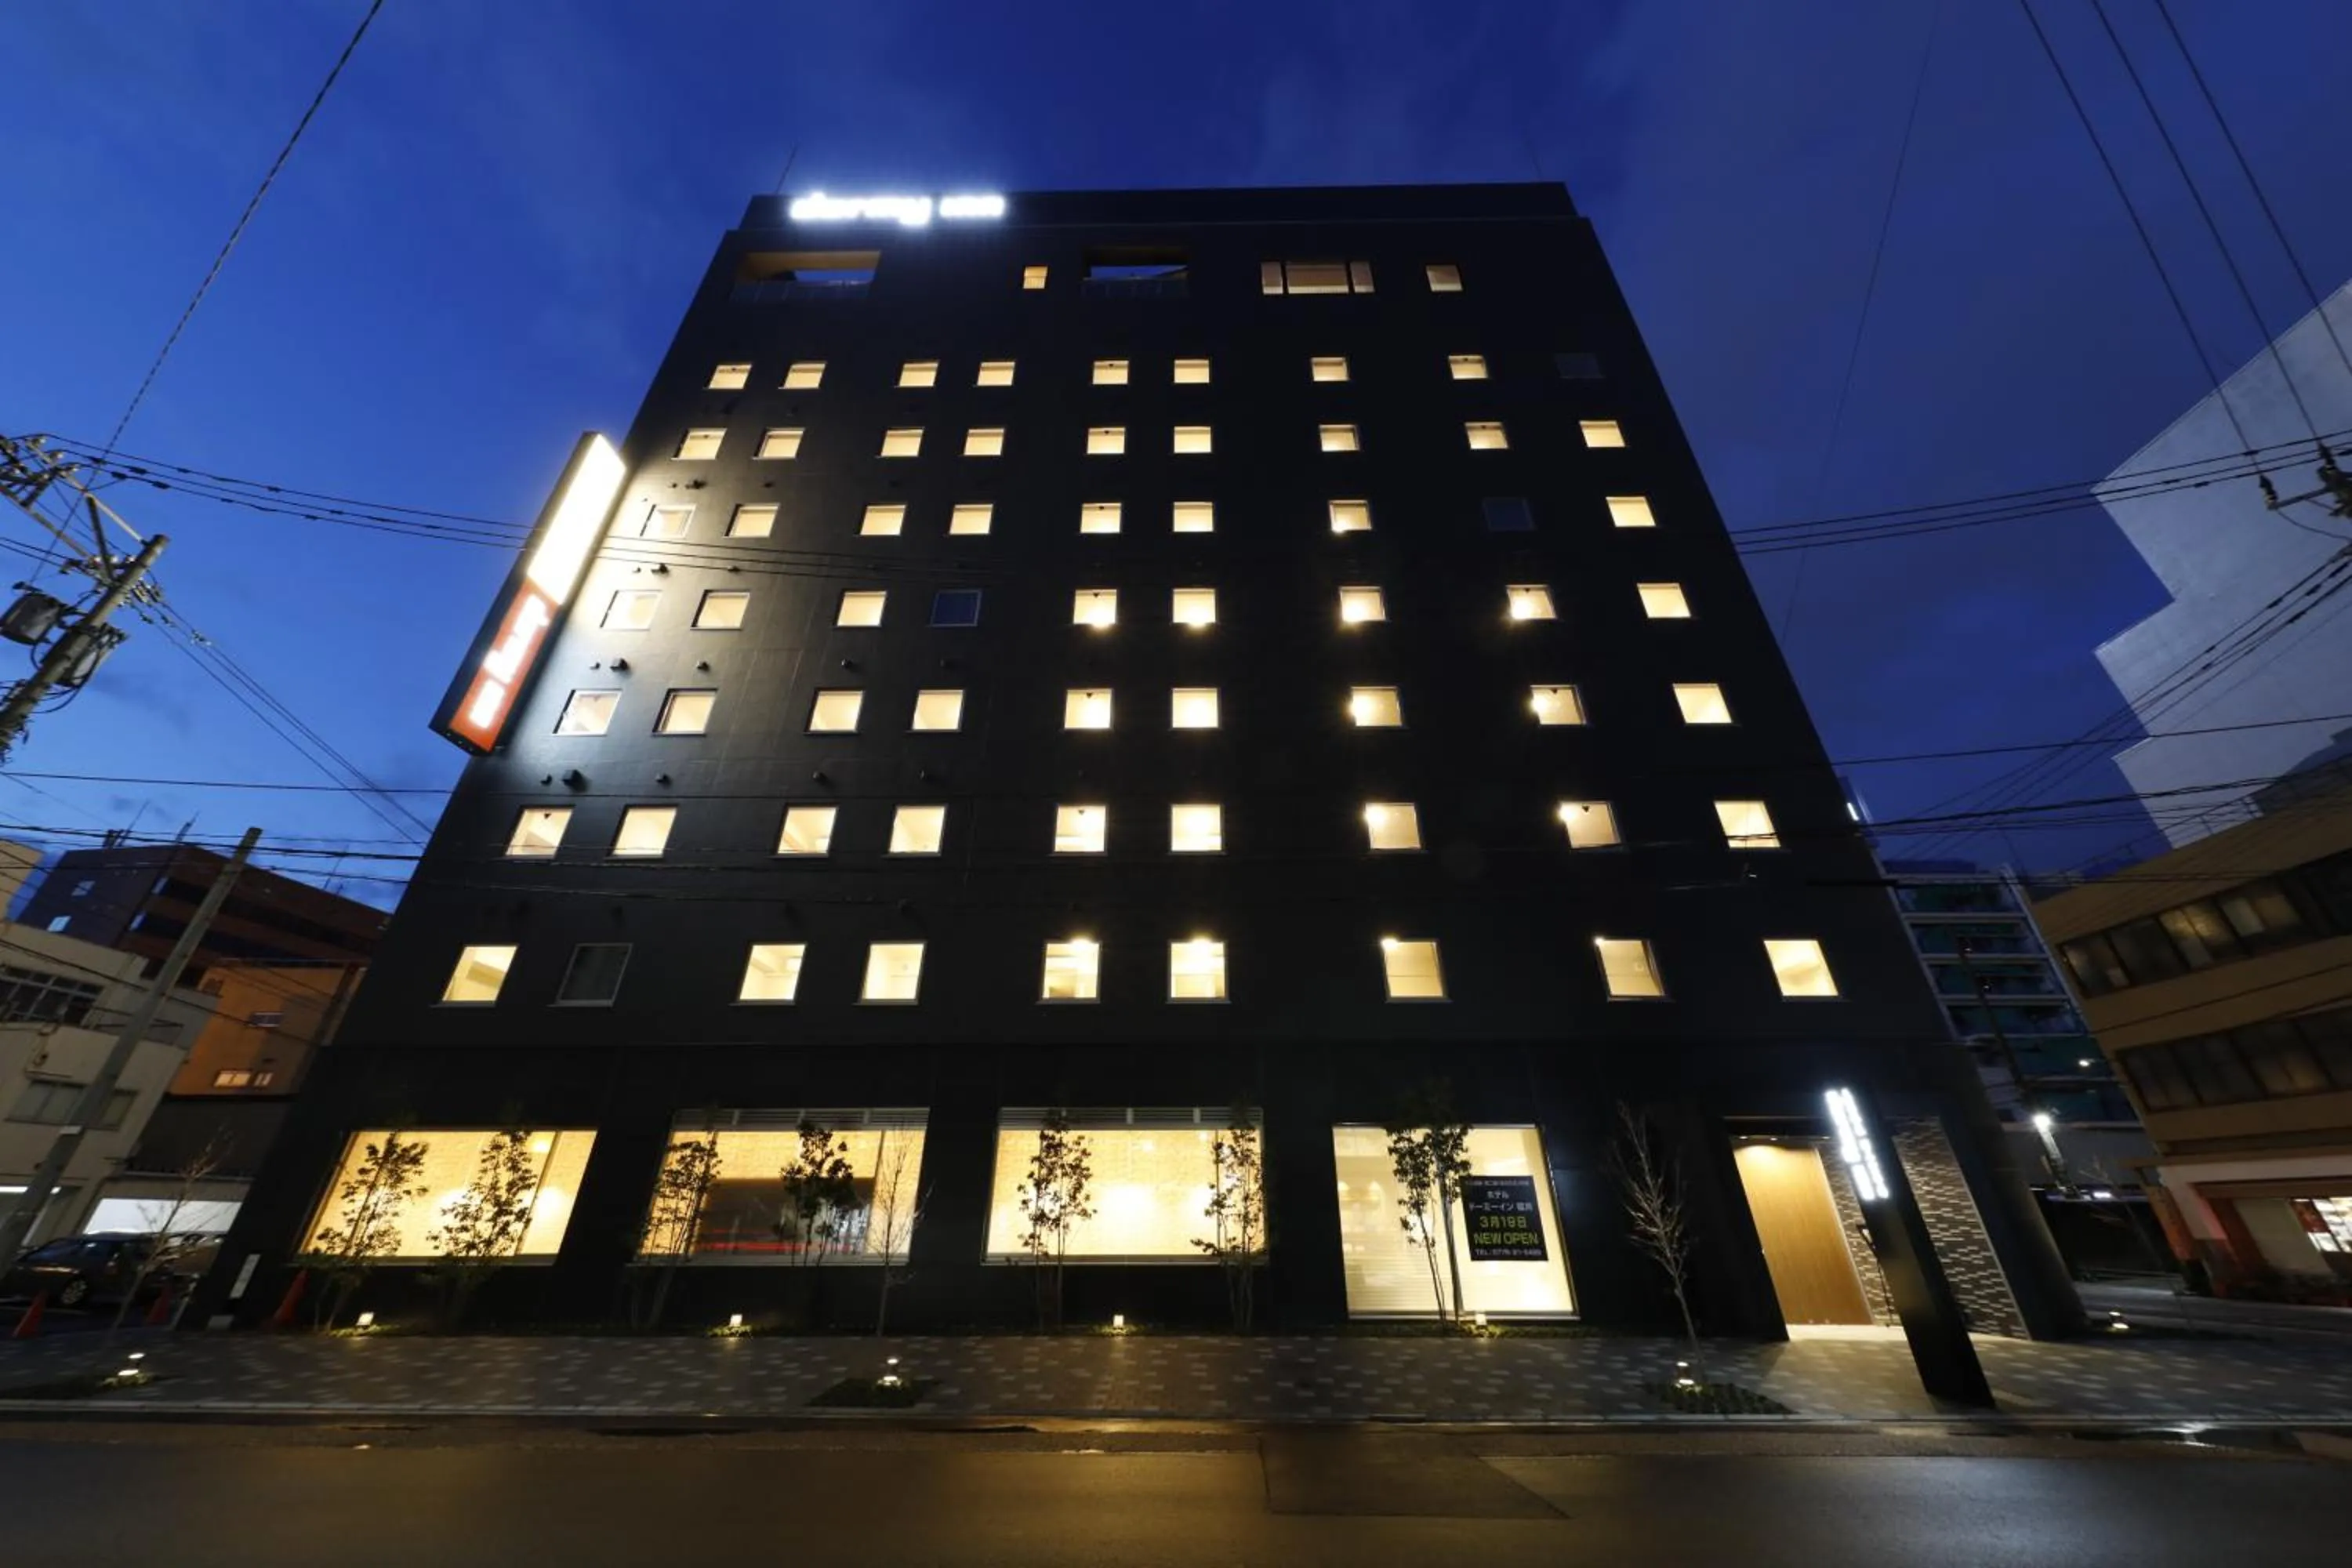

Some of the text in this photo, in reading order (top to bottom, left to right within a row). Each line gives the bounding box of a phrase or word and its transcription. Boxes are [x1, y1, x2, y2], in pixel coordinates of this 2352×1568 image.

[1479, 1216, 1526, 1228] 3月19日
[1474, 1232, 1539, 1244] NEW OPEN
